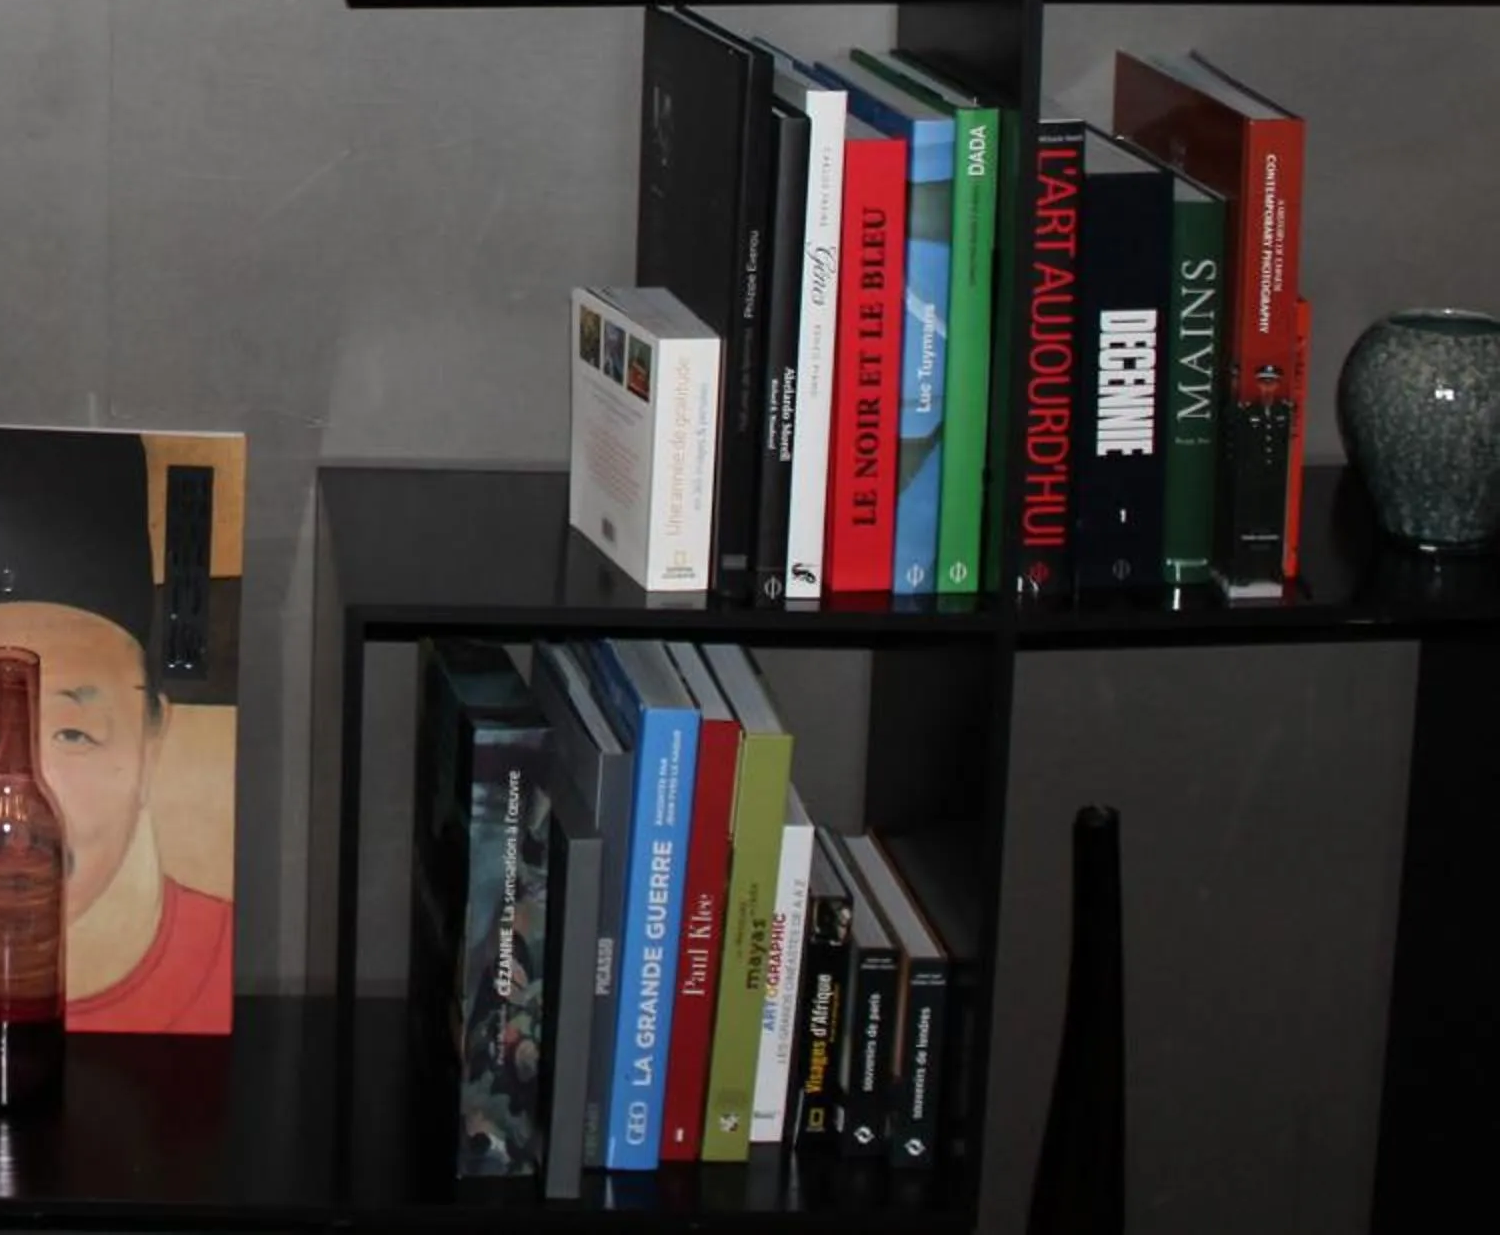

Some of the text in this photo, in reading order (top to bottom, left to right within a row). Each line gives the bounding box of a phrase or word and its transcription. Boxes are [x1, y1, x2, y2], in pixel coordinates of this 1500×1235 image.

[966, 125, 987, 176] DADA
[851, 206, 888, 527] LE NOIR ET LE BLEU
[1023, 147, 1078, 546] L'ART AUJOURD'HUI
[1096, 309, 1158, 456] DECENNIE
[1175, 257, 1218, 422] MAINS
[915, 382, 933, 412] Luc
[502, 838, 520, 903] sensation
[504, 825, 519, 835] à
[500, 906, 516, 922] La
[645, 839, 674, 939] GUERRE
[496, 927, 514, 997] CÉZANNE
[594, 937, 617, 996] PICASSO
[682, 892, 714, 998] Paul Klee
[744, 918, 768, 990] mayas
[638, 946, 664, 1049] GRANDE
[804, 973, 834, 1093] Visages d'Afrique
[632, 1053, 653, 1086] LA
[861, 992, 884, 1092] souvenirs de paris
[911, 1006, 931, 1119] souvenirs de londres
[626, 1100, 649, 1146] GEO
